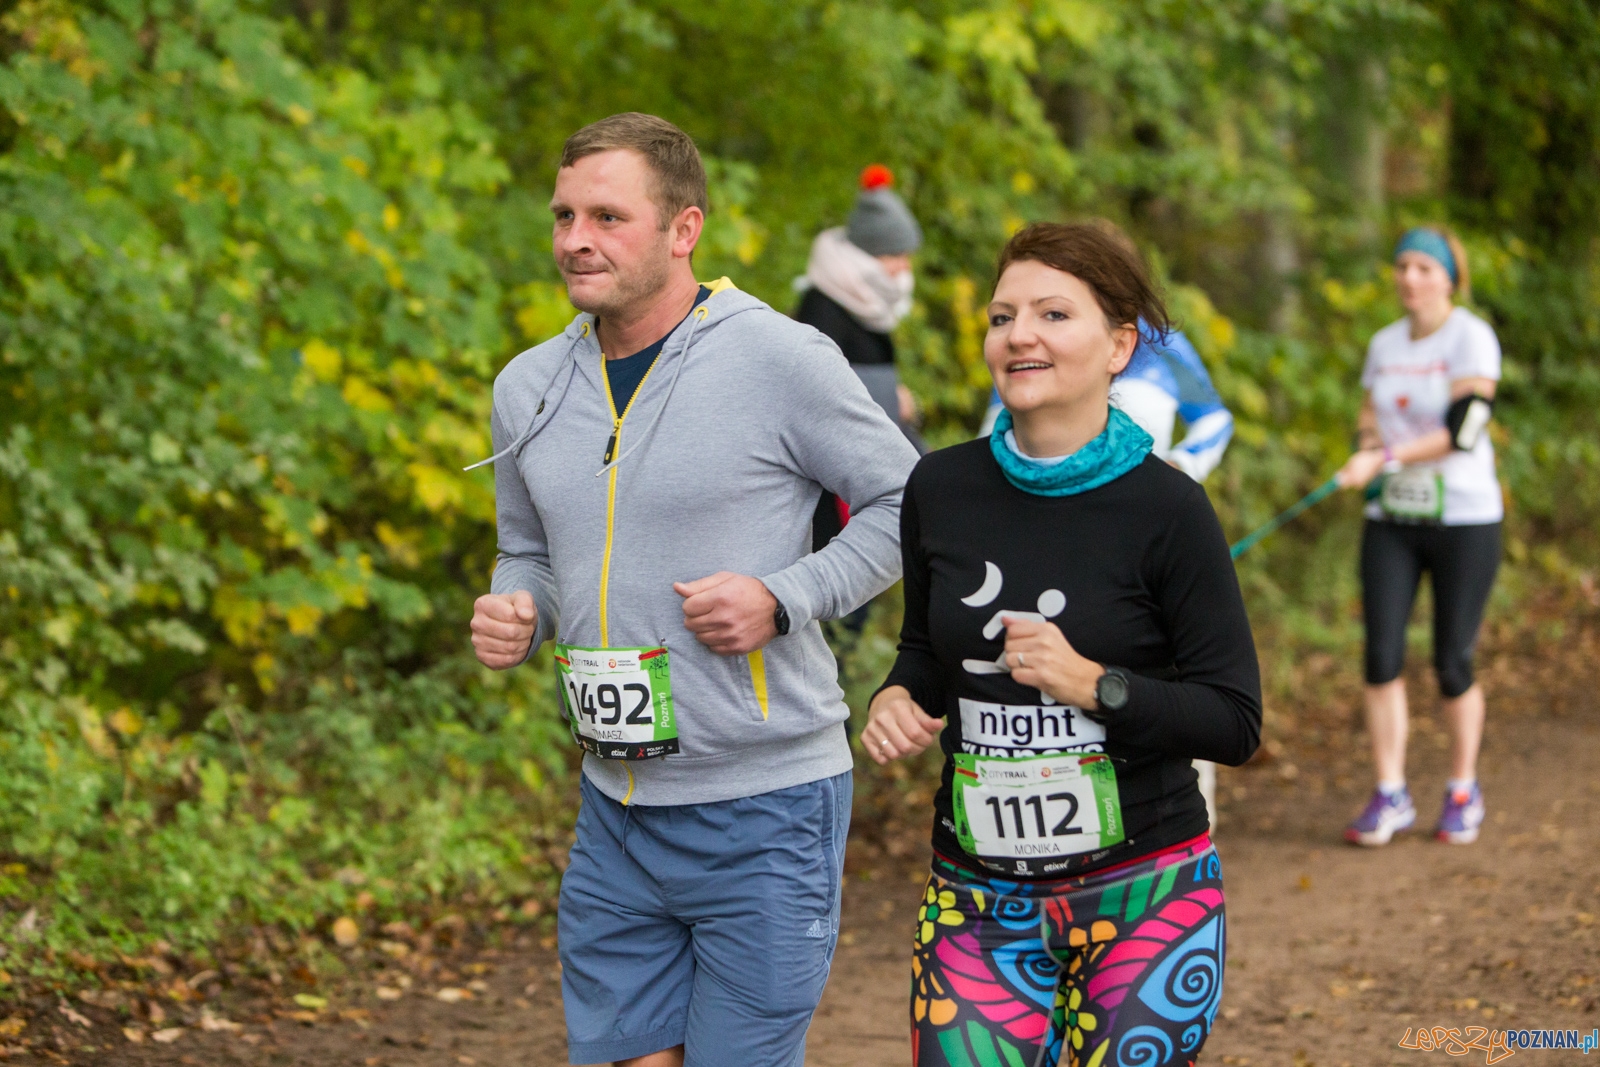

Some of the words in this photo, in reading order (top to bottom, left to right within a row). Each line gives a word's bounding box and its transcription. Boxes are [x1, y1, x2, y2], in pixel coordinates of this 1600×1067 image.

[569, 681, 653, 725] 1492
[659, 692, 671, 728] Poznań
[979, 706, 1076, 746] night
[985, 792, 1083, 840] 1112
[1106, 797, 1118, 836] Poznań
[1014, 842, 1061, 855] MONIKA
